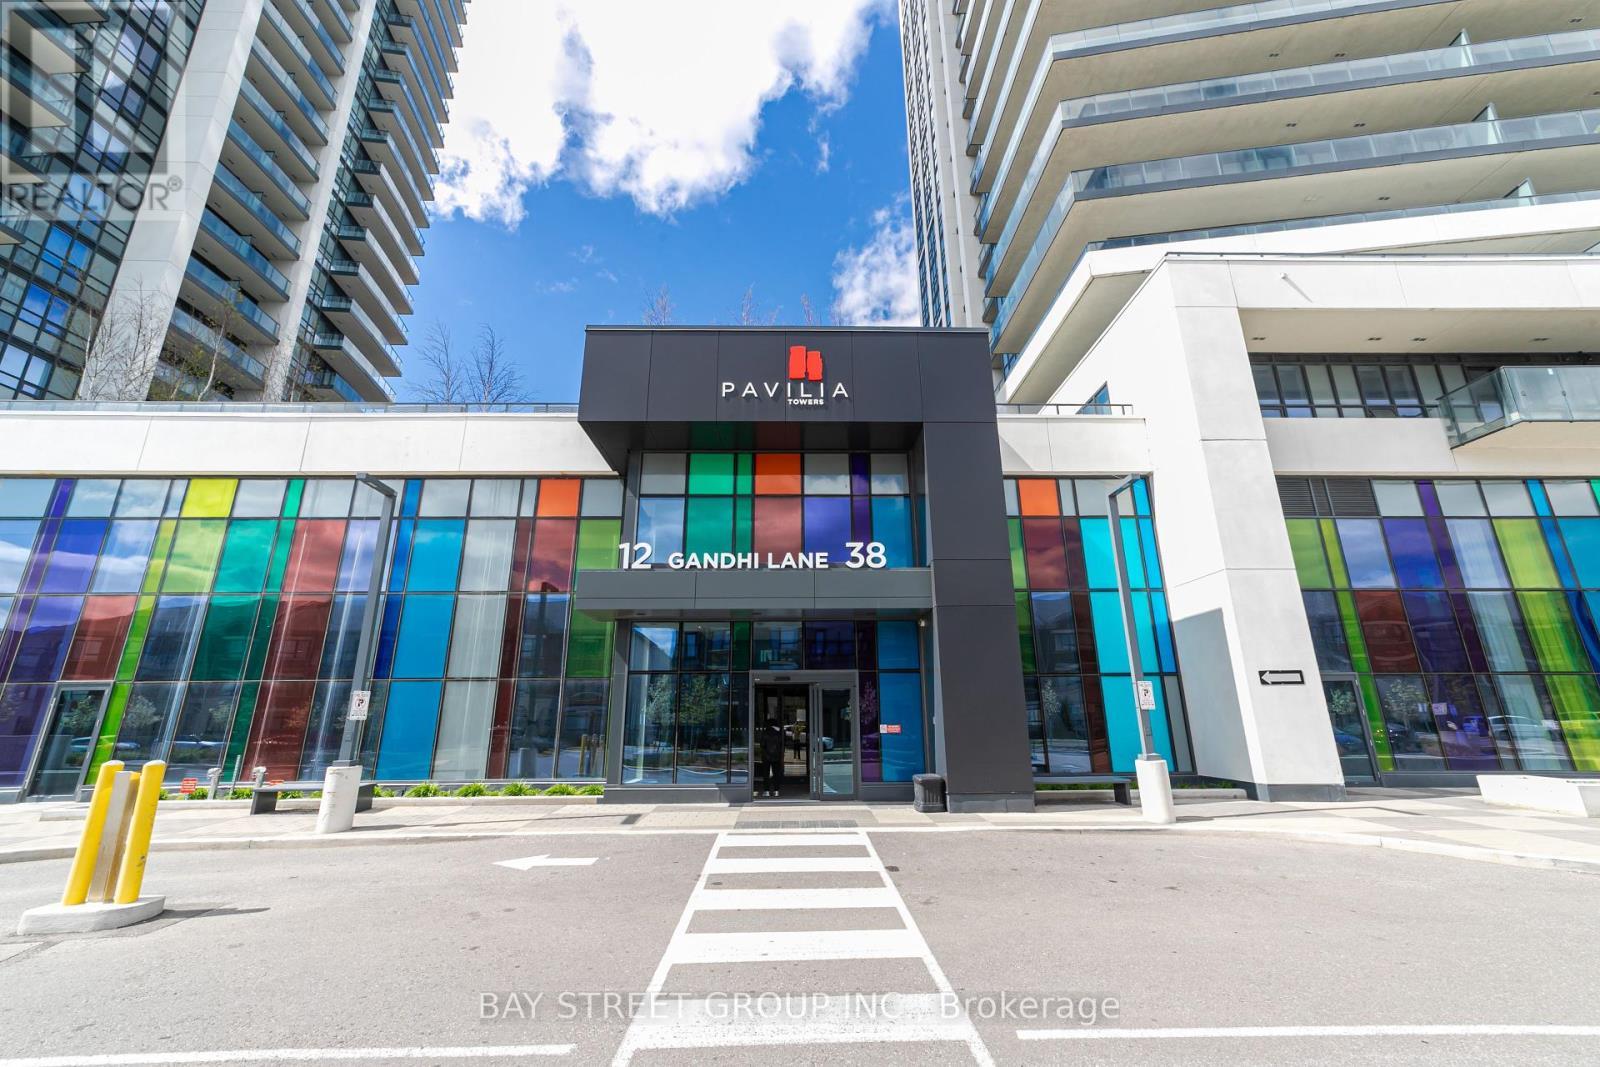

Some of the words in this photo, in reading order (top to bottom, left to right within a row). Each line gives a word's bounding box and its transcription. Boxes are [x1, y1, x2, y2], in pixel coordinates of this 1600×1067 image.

[721, 381, 848, 398] PAVILIA
[787, 398, 825, 406] TOWERS
[618, 542, 652, 570] 12
[667, 552, 760, 570] GANDHI
[767, 552, 829, 570] LANE
[844, 541, 888, 570] 38
